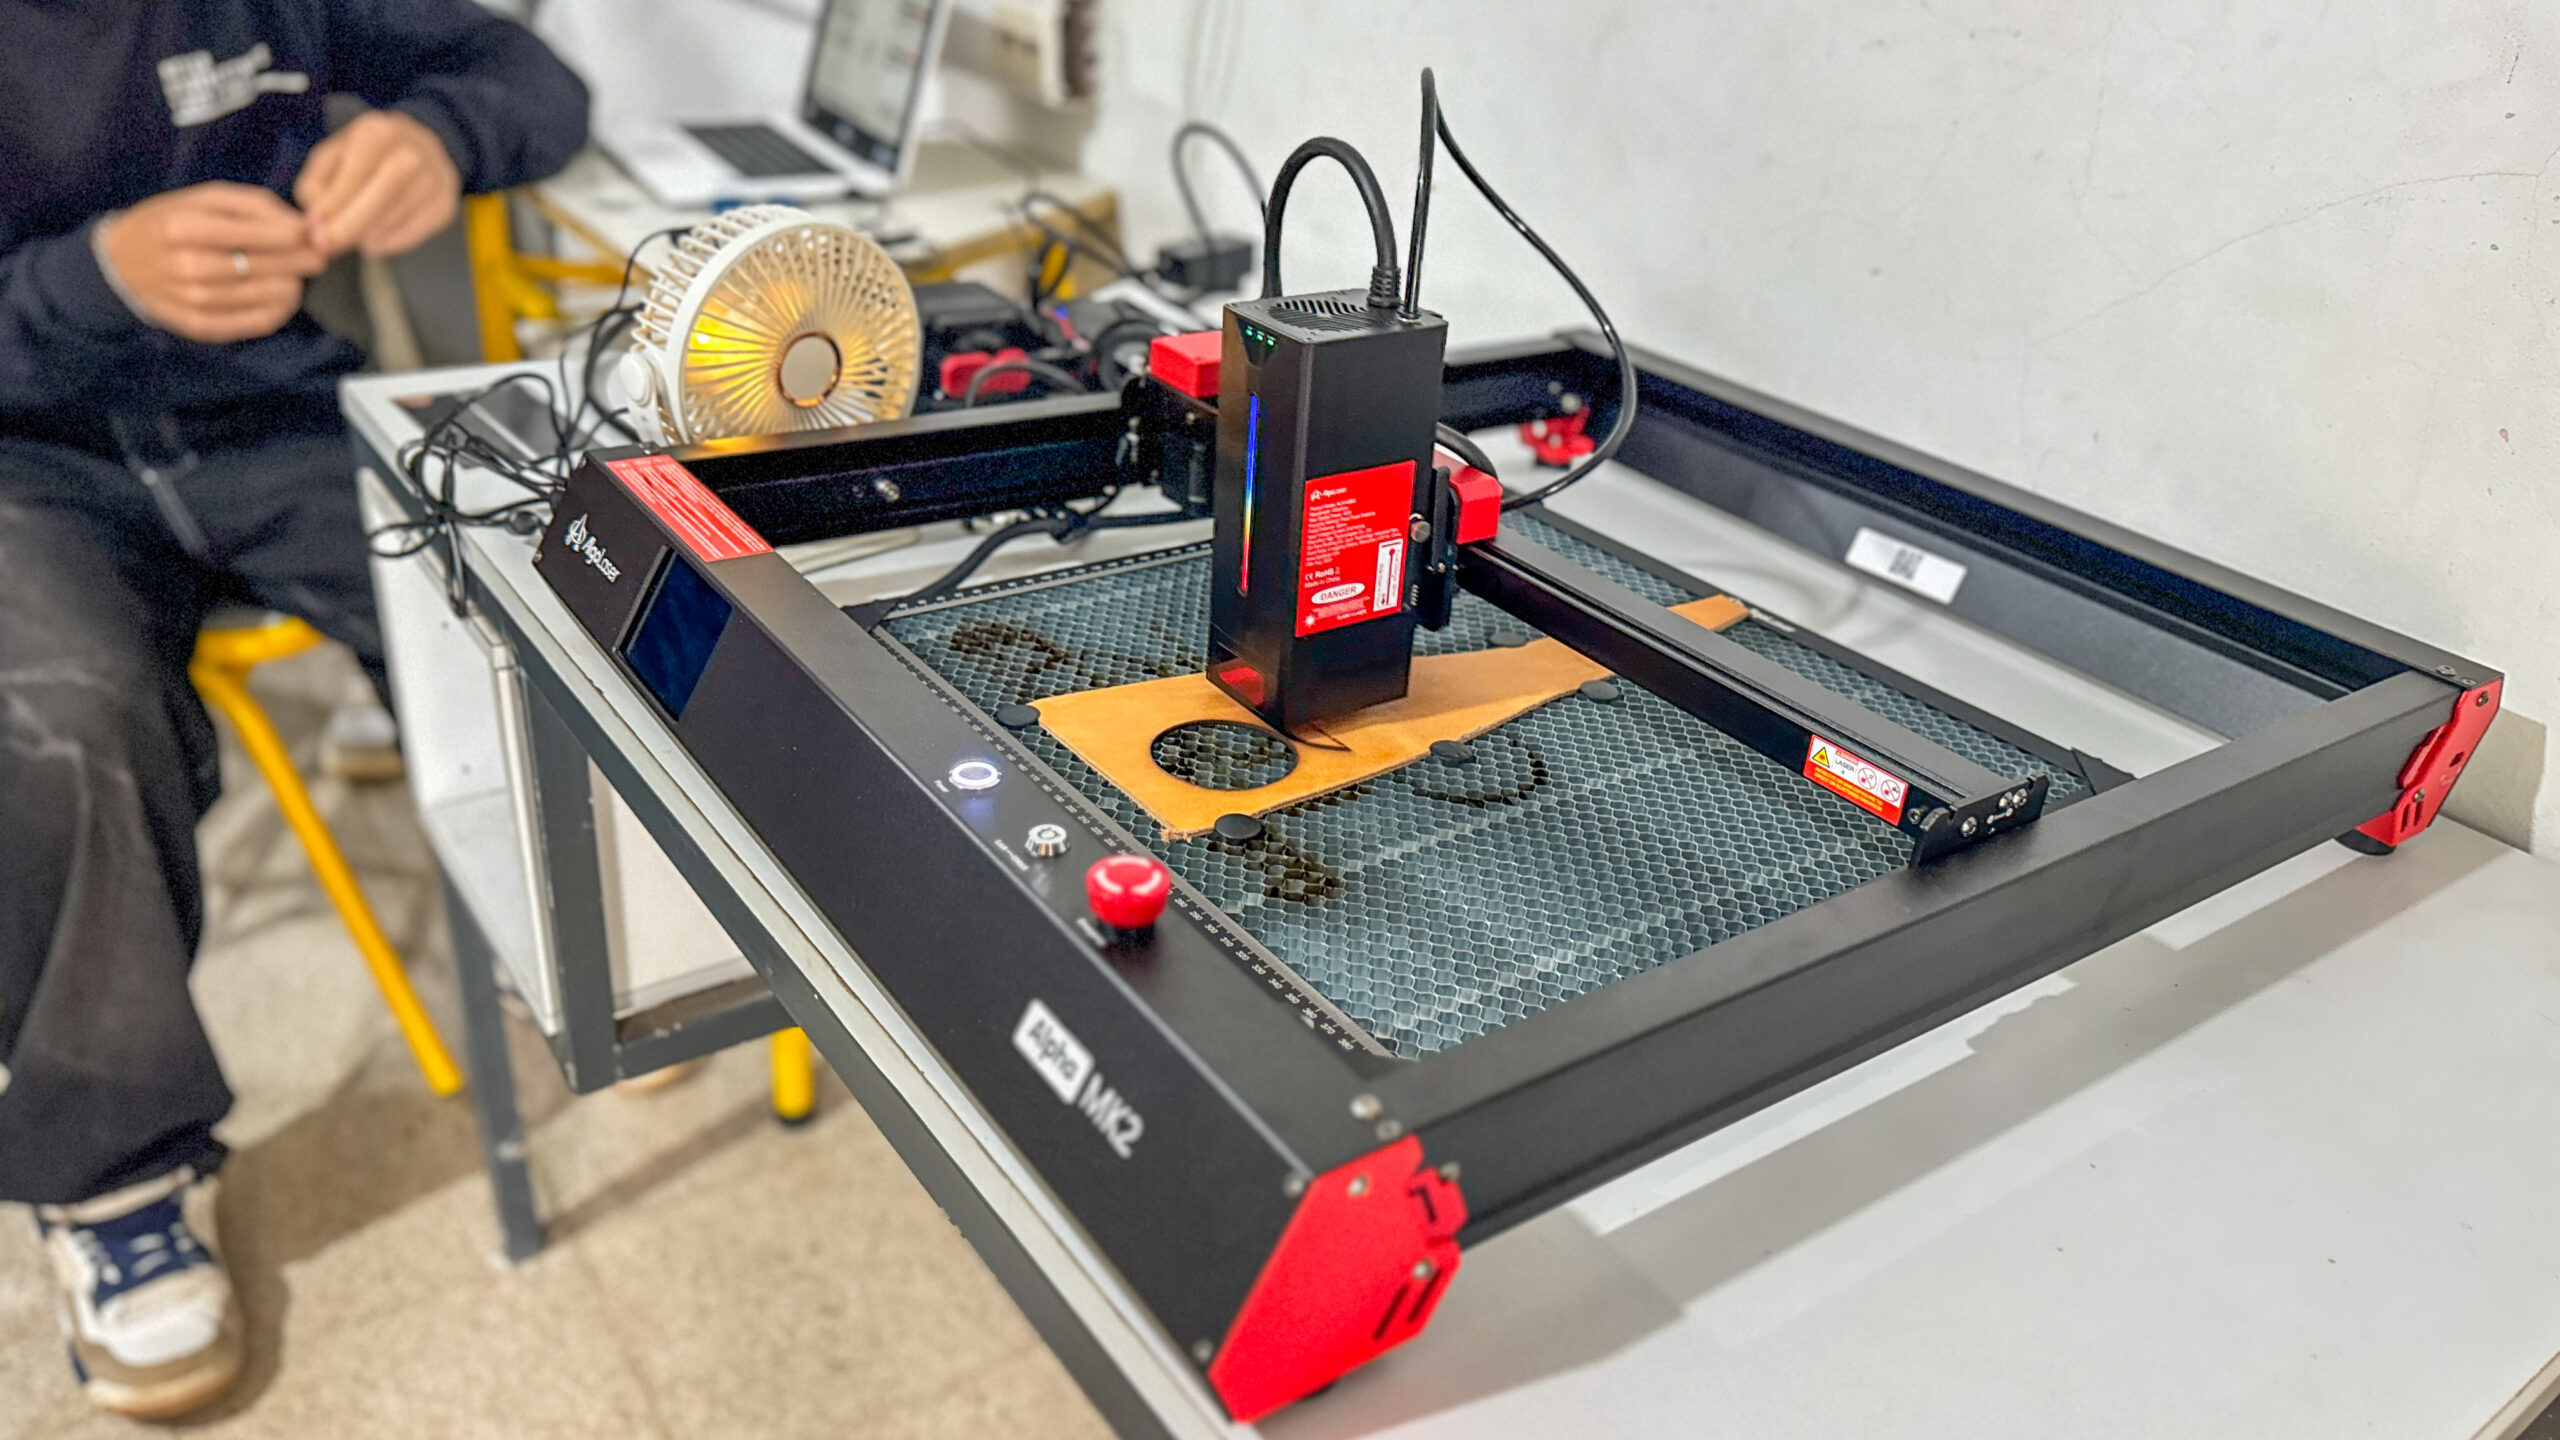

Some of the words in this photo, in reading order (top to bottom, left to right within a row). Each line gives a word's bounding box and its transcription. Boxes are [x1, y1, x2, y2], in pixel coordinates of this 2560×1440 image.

[1320, 585, 1357, 601] DANGER
[1835, 758, 1855, 772] LASER
[1077, 1072, 1145, 1160] MK2
